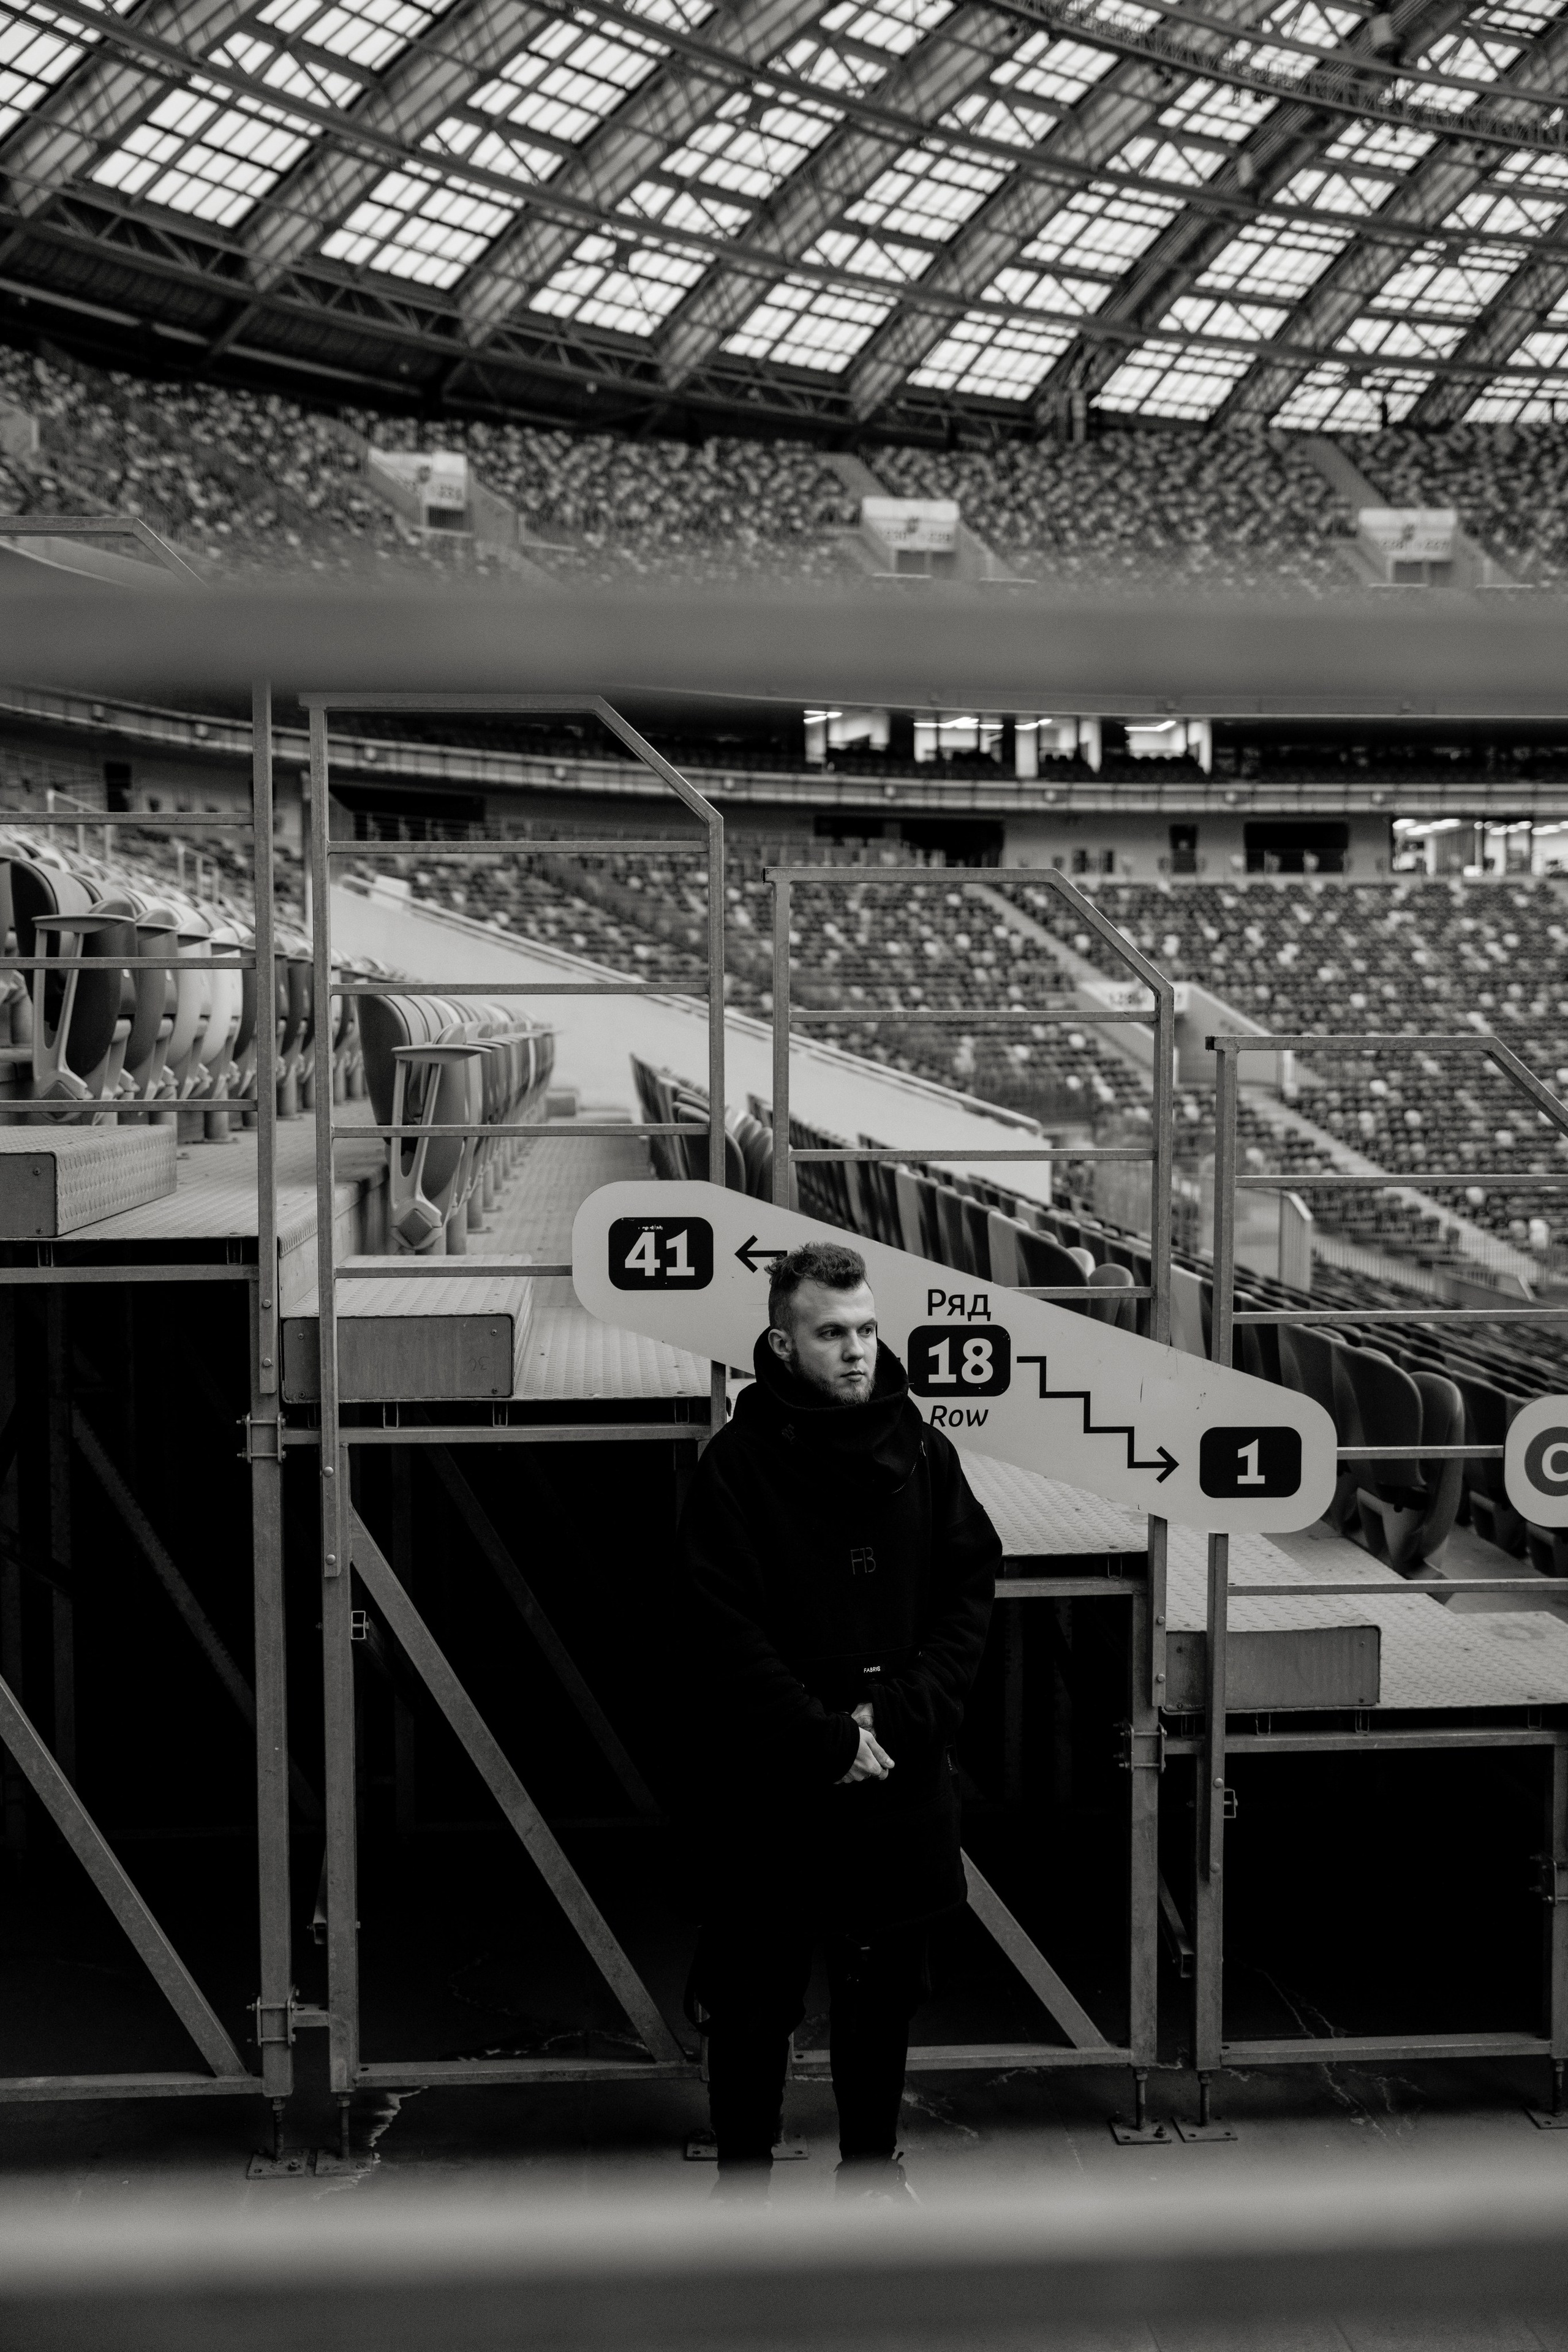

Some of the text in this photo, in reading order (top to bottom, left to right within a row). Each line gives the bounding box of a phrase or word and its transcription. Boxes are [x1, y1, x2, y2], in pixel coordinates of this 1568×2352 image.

[625, 1229, 695, 1276] 41
[927, 1289, 992, 1322] Ряд
[928, 1336, 993, 1384] 18
[929, 1405, 989, 1427] Row
[1237, 1438, 1265, 1484] 1
